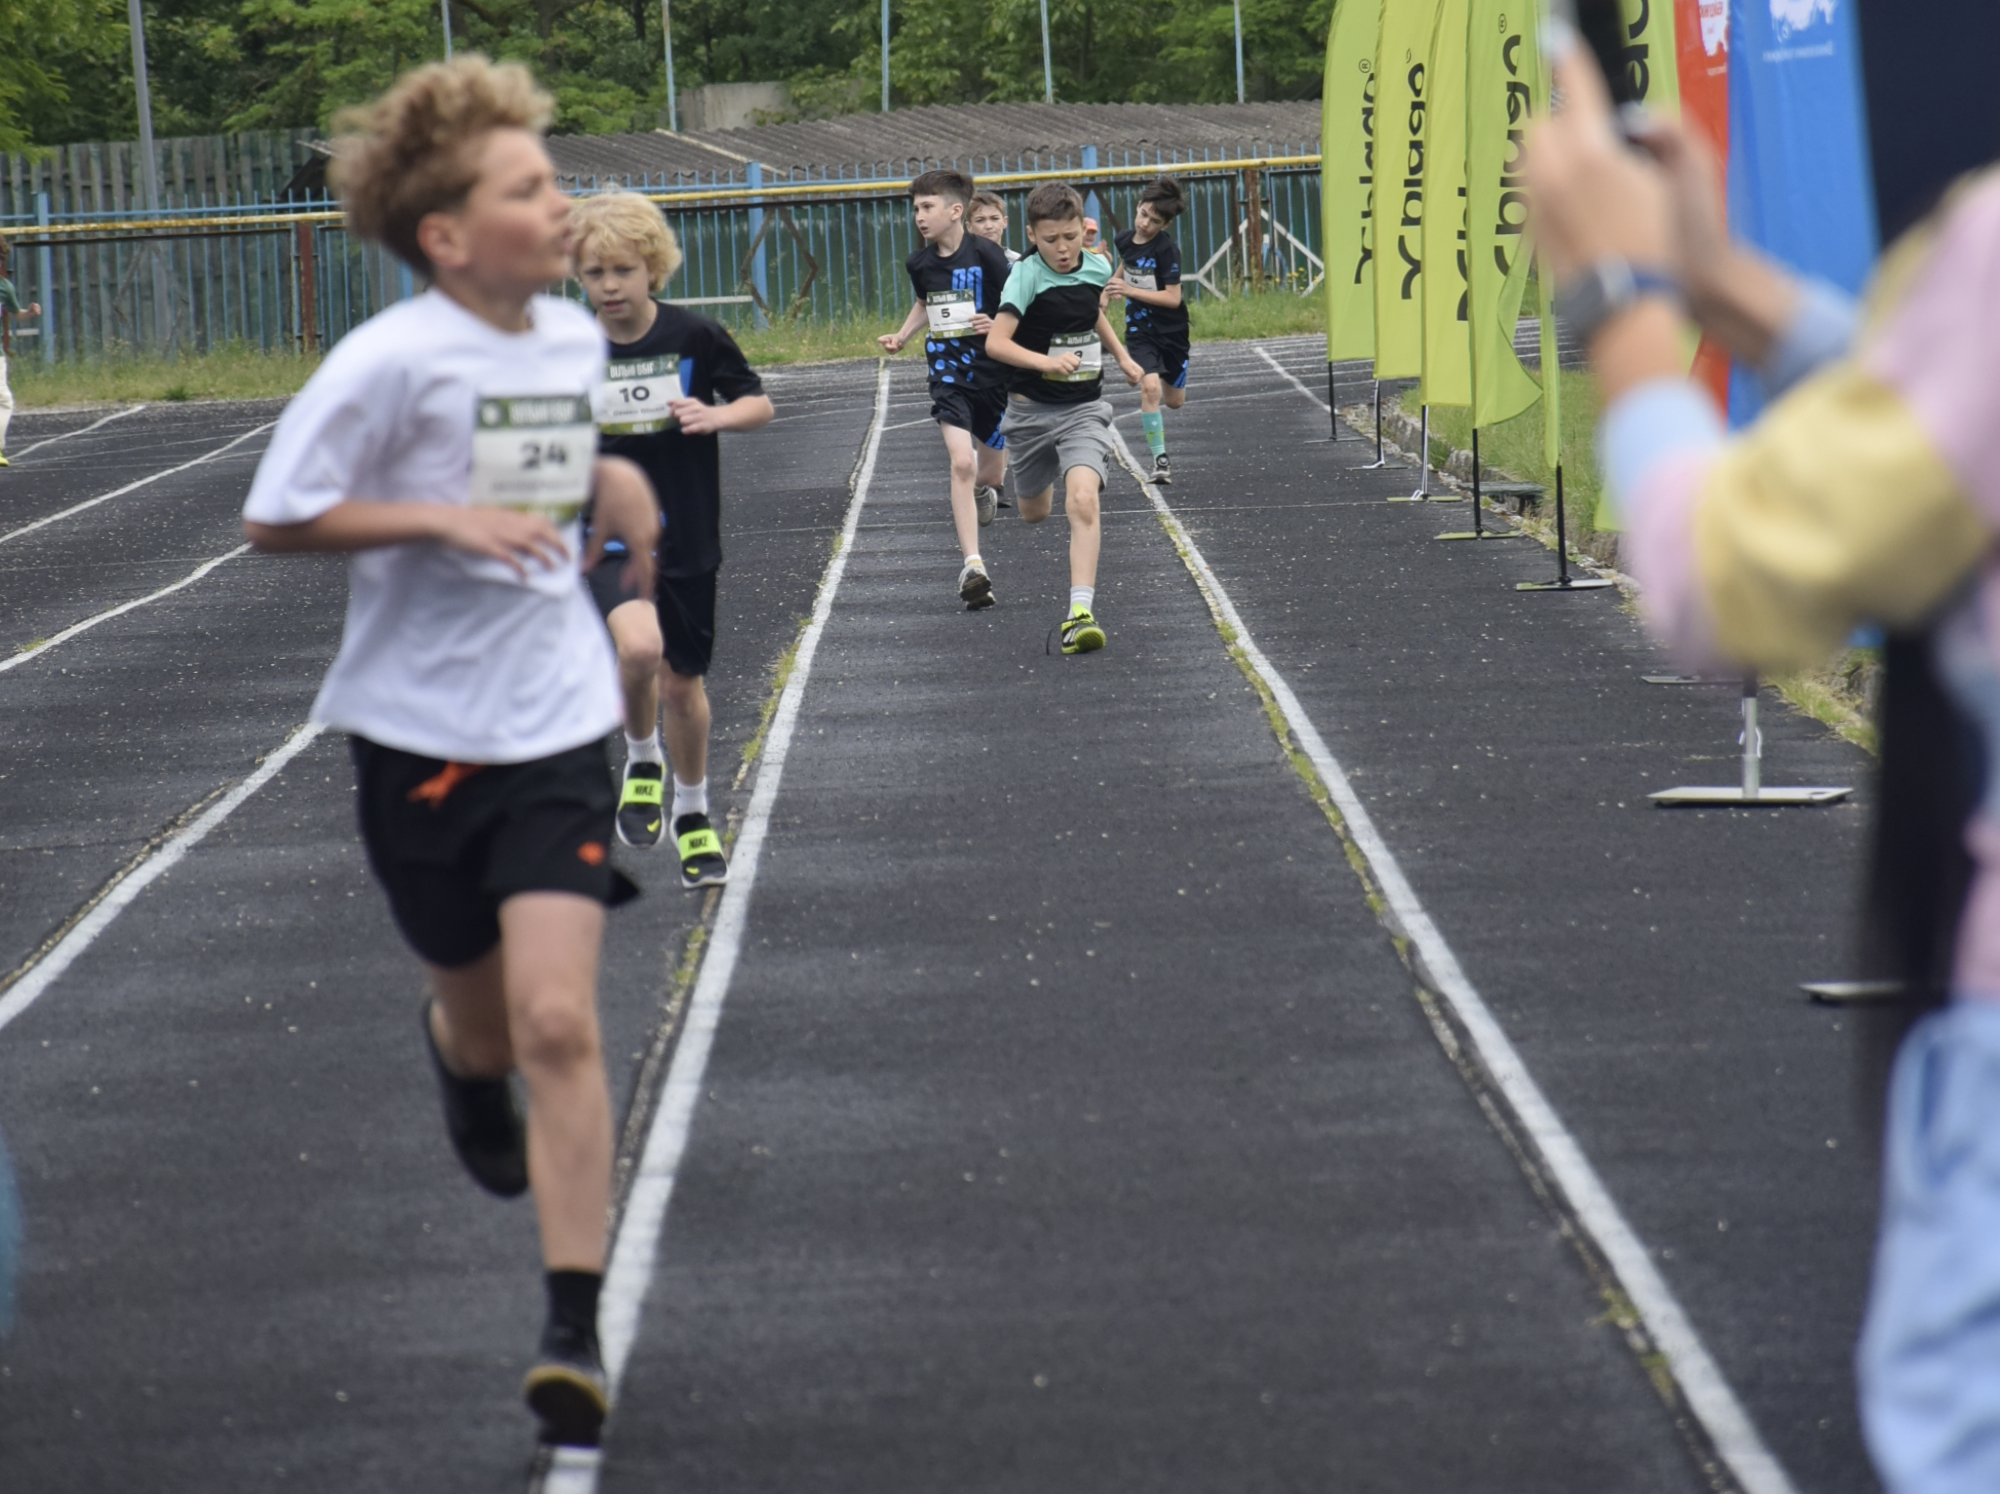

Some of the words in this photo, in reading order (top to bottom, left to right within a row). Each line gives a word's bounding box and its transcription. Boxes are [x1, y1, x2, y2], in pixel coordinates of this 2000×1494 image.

[941, 308, 951, 318] 5
[619, 386, 650, 403] 10
[520, 440, 567, 470] 24
[634, 784, 655, 797] NIKE
[688, 836, 708, 850] NIKE
